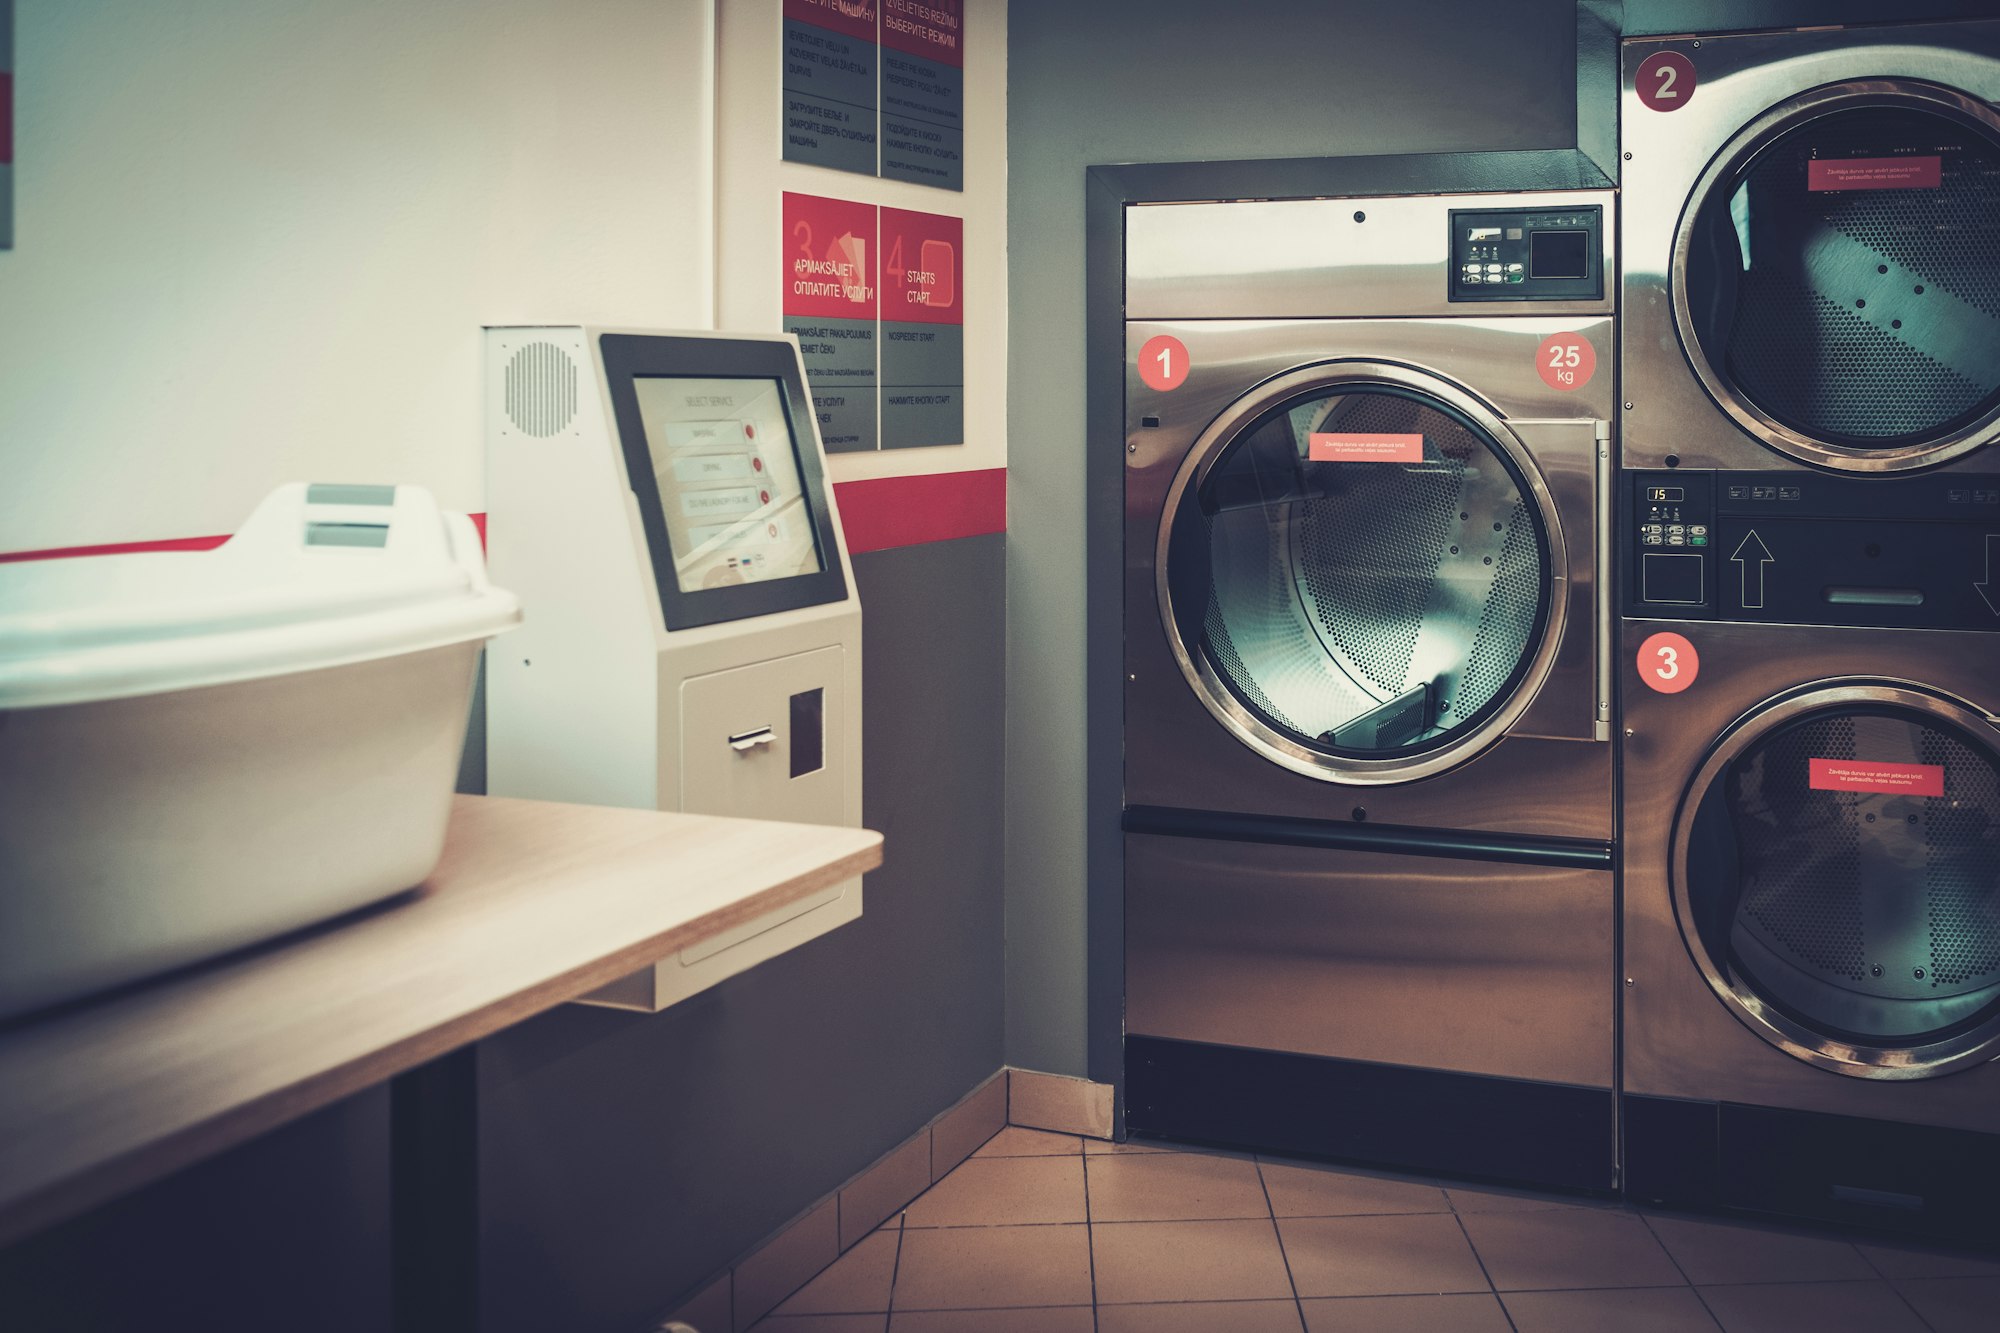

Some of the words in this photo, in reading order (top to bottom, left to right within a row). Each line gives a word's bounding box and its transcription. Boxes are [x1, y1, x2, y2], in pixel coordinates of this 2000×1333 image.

[839, 0, 875, 22] МАШИНУ
[886, 15, 926, 38] ВЫБЕРИТЕ
[929, 28, 955, 48] РЕЖИМ
[789, 63, 812, 77] DURVIS
[1655, 66, 1677, 98] 2
[845, 113, 850, 123] И
[789, 118, 820, 132] ЗАКРОЙТЕ
[821, 125, 840, 137] ДВЕРЬ
[789, 135, 817, 148] МАШИНЫ
[794, 220, 813, 280] 3
[795, 259, 854, 277] APMAKSĀJIET
[886, 235, 905, 288] 4
[907, 270, 936, 285] STARTS
[794, 281, 840, 298] ОПЛАТИТЕ
[842, 285, 874, 300] УСЛУГИ
[907, 290, 930, 304] СТАРТ
[919, 333, 935, 342] START
[1156, 349, 1171, 378] 1
[1549, 346, 1580, 367] 25
[1557, 369, 1574, 384] kg
[685, 396, 708, 407] SELECT
[710, 396, 734, 407] SERVICE
[1655, 489, 1666, 500] 15
[1656, 646, 1678, 679] 3
